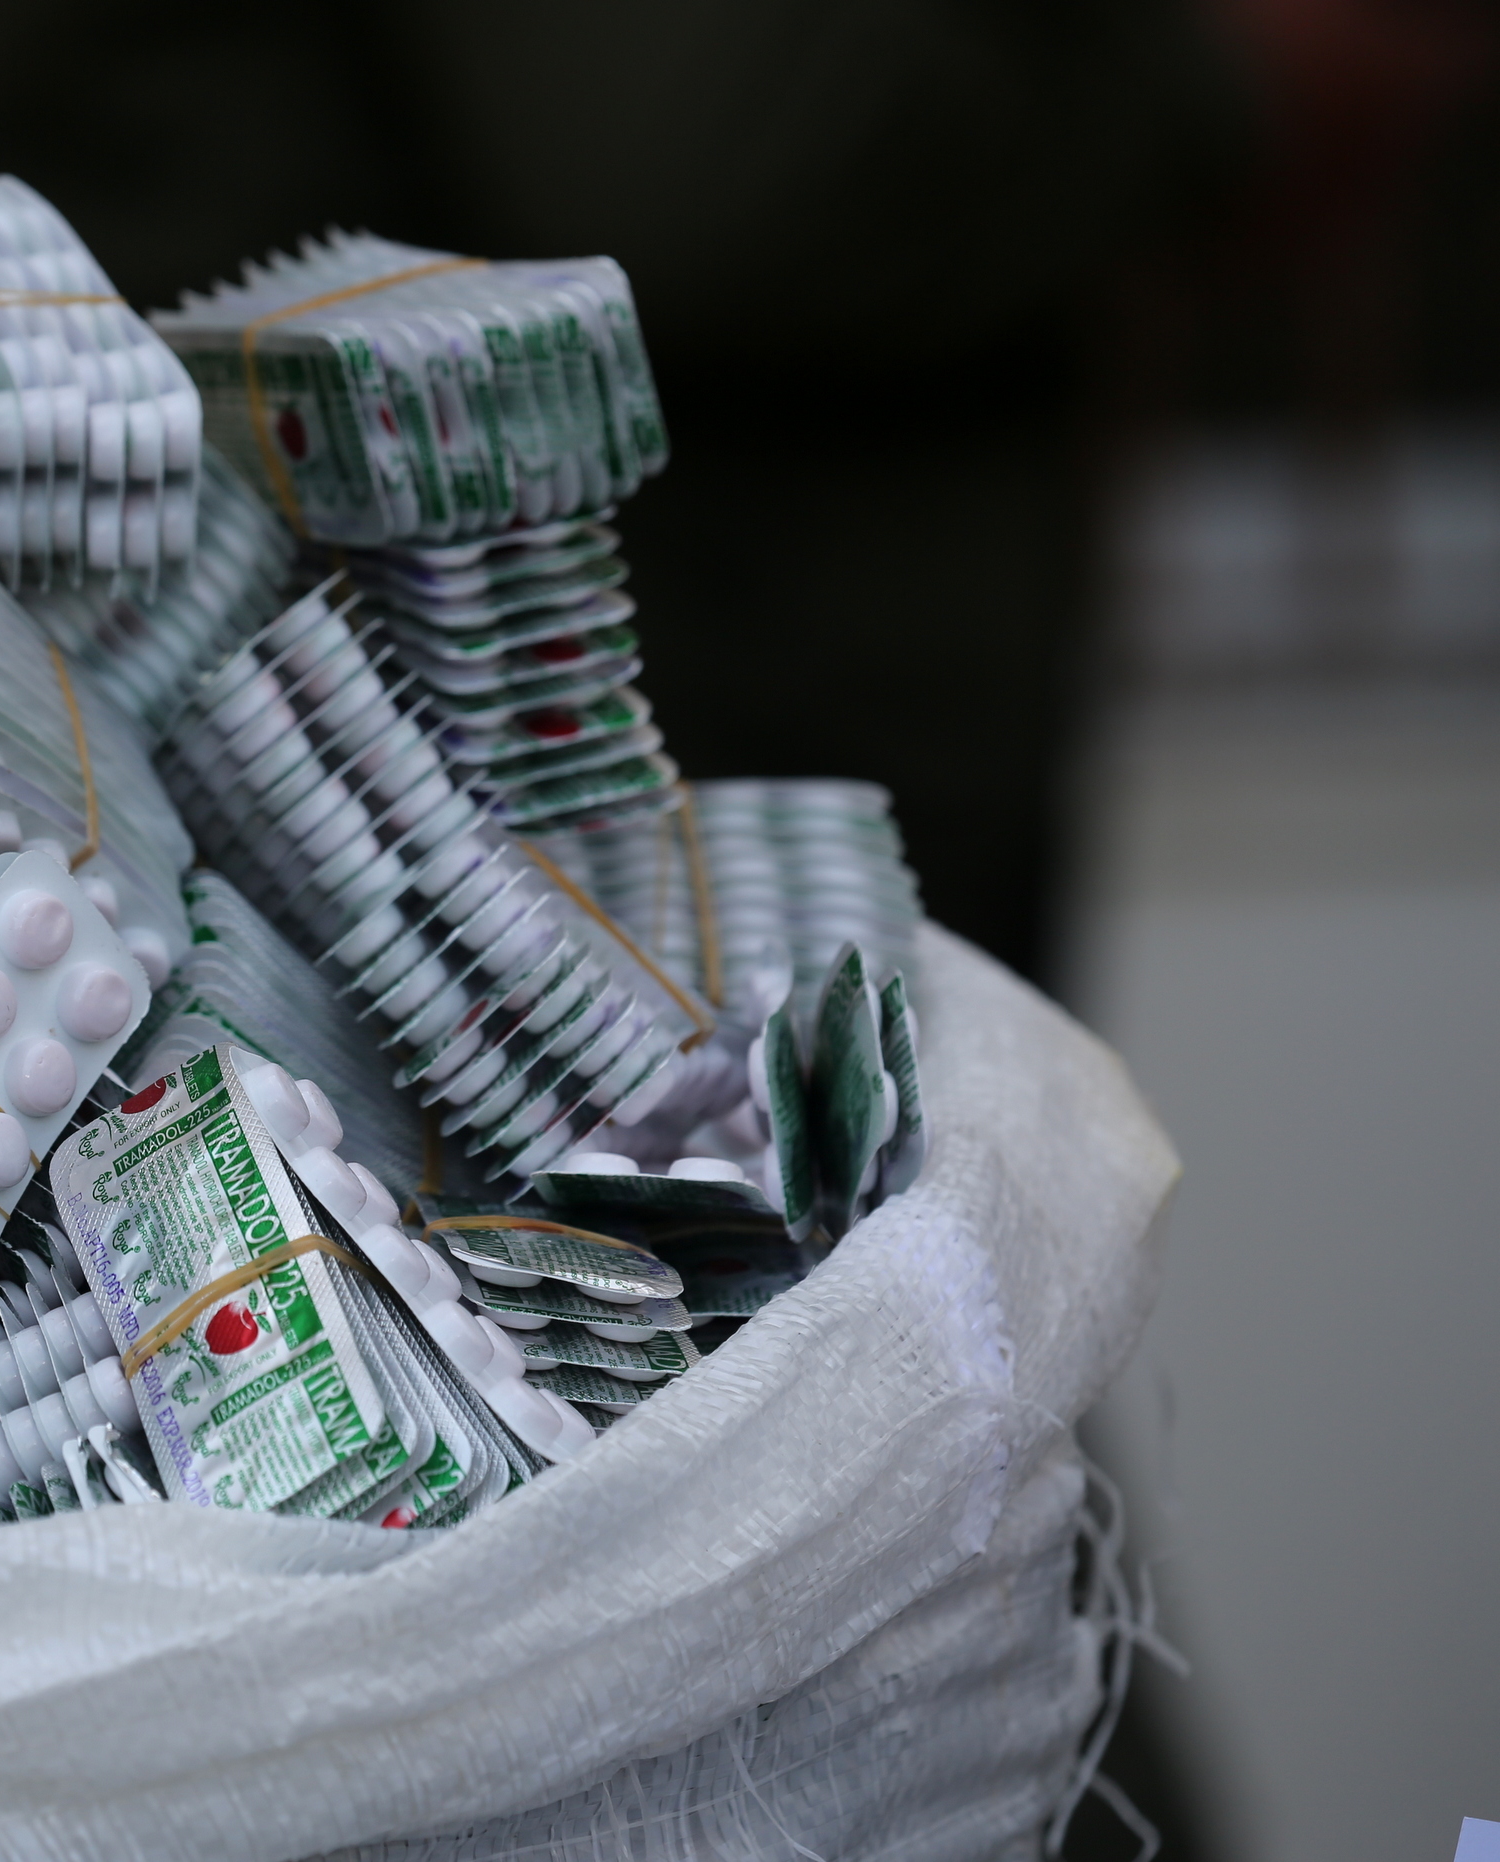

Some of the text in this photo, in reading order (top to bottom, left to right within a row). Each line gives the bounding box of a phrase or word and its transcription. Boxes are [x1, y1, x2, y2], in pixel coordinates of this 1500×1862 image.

[114, 1135, 130, 1149] FOR
[160, 1102, 182, 1118] ONLY
[116, 1105, 211, 1173] TRAMADOL-225
[93, 1175, 113, 1205] Royal
[183, 1134, 210, 1174] TRAMADOL
[198, 1171, 233, 1231] HYDROCHLORIDE
[221, 1228, 245, 1261] TABLETS
[184, 1171, 200, 1196] coated
[141, 1208, 152, 1221] the
[205, 1112, 309, 1312] TRAMADOL225
[112, 1223, 135, 1255] Royal
[146, 1220, 161, 1242] reach
[132, 1274, 158, 1308] Royal
